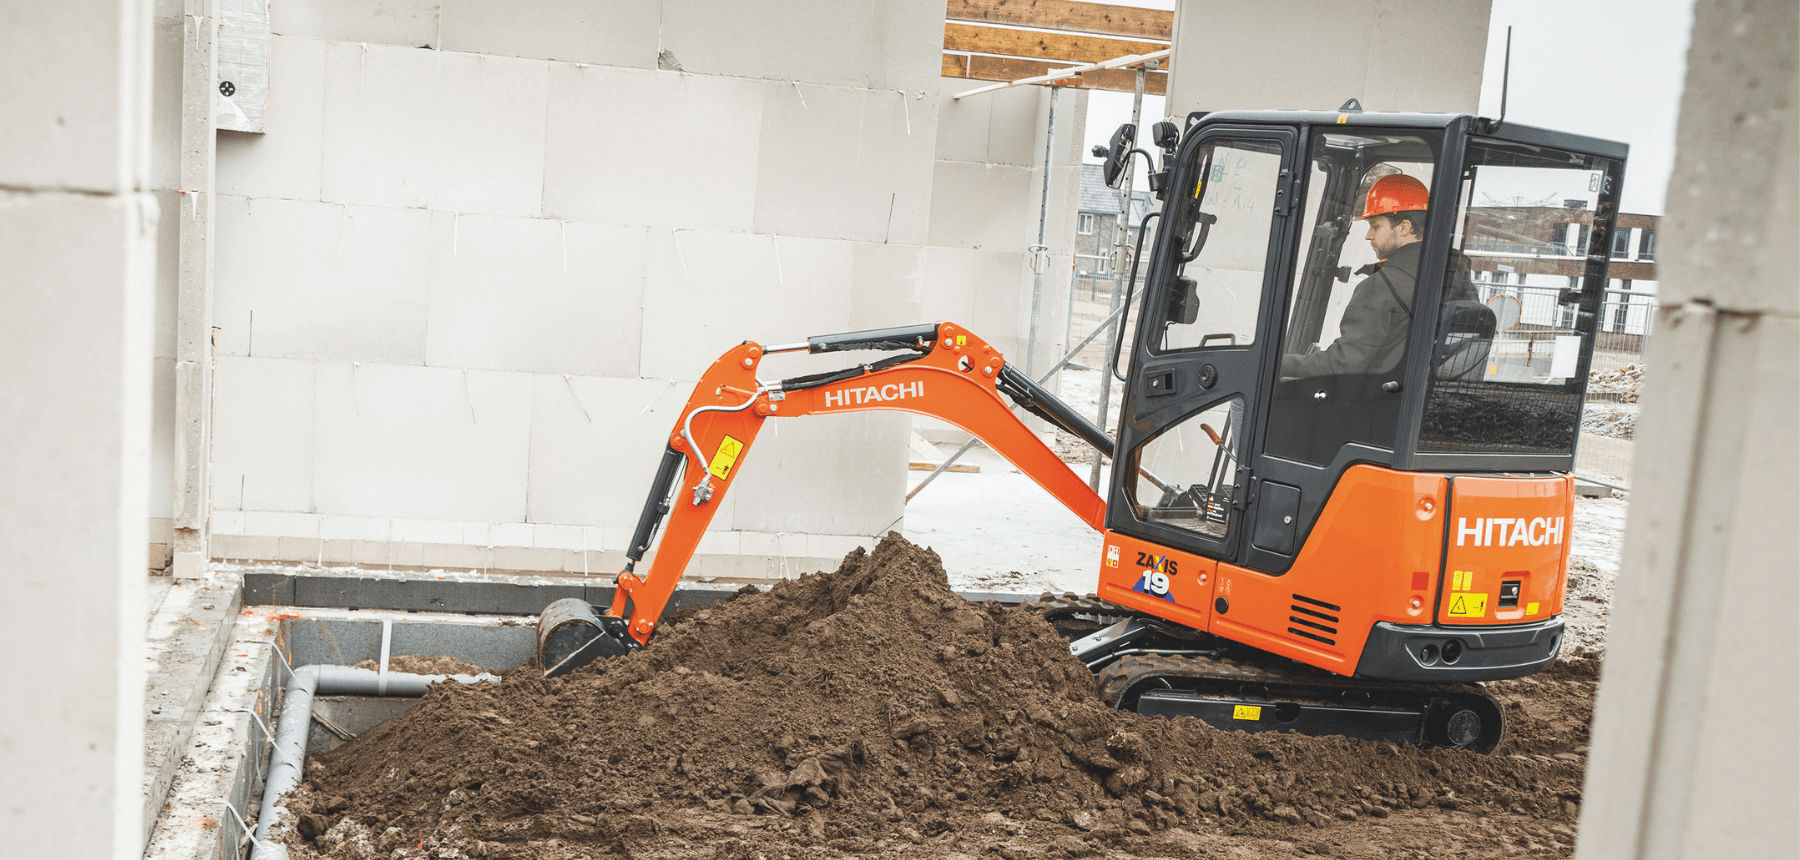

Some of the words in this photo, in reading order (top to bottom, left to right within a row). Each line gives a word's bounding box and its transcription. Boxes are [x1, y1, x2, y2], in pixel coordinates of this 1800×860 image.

[825, 381, 924, 407] HITACHI
[1457, 517, 1565, 547] HITACHI
[1136, 551, 1178, 576] ZAXIS
[1143, 569, 1170, 598] 19
